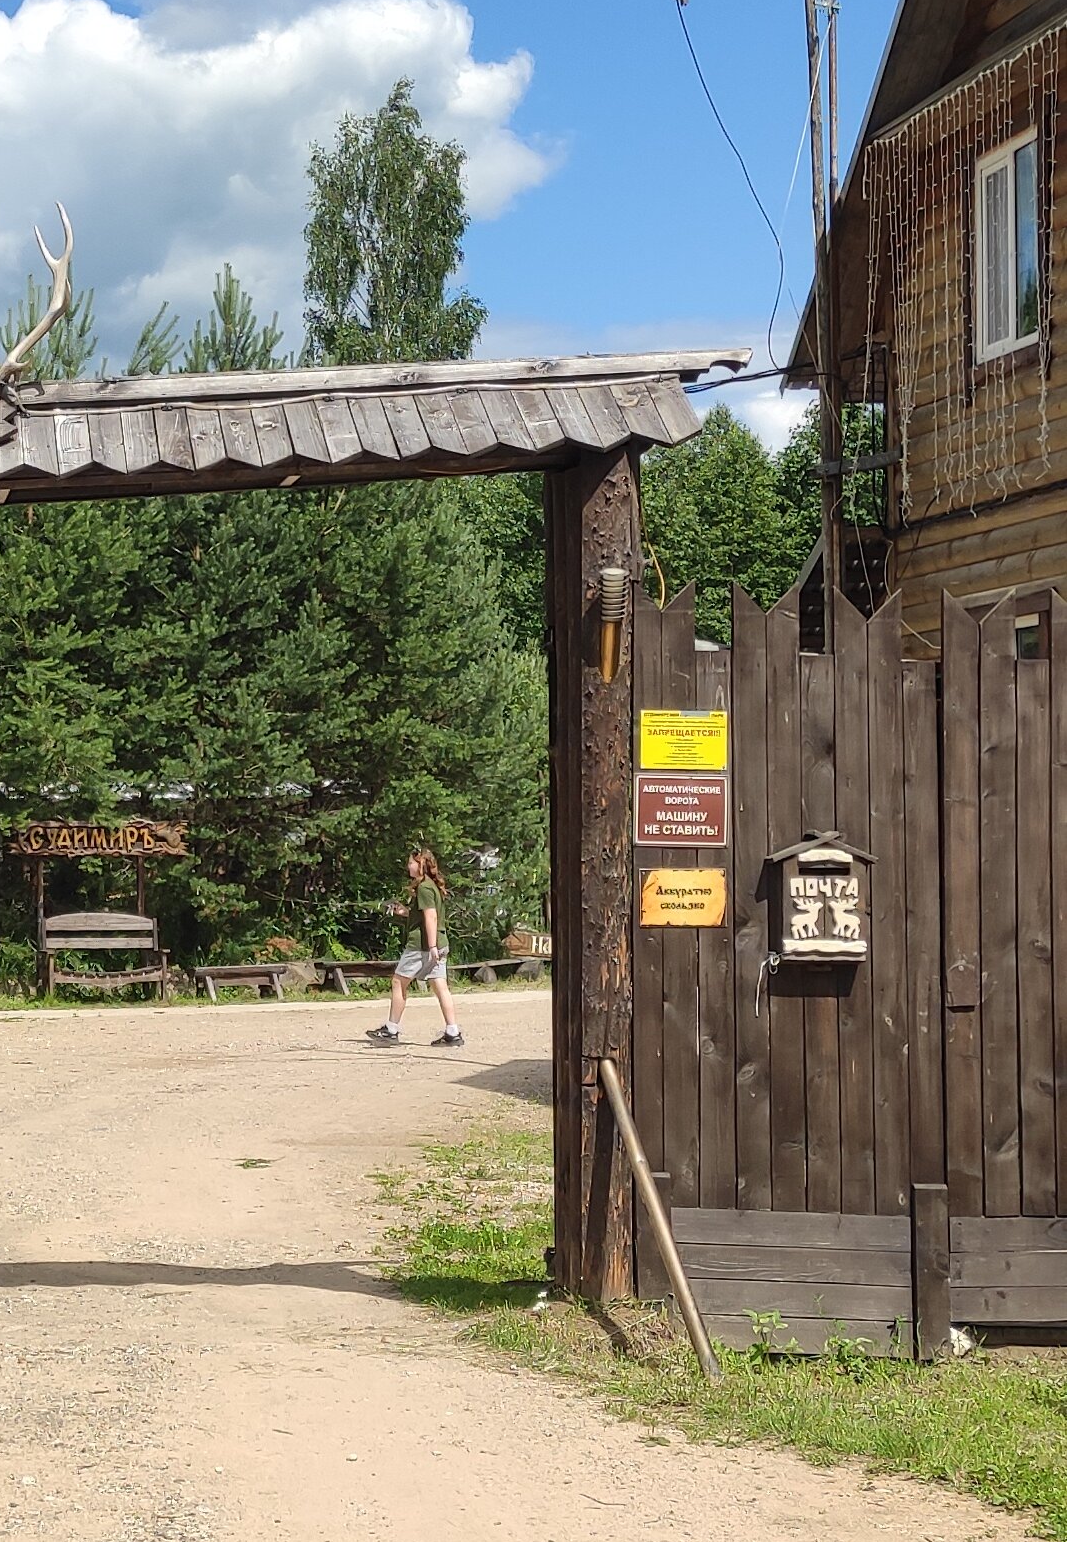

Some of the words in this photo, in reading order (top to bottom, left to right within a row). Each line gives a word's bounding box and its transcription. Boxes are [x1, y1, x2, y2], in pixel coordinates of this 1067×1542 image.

[642, 784, 721, 794] АВТОМАТИЧЕСКИЕ
[664, 796, 700, 805] ВОРОТА
[656, 810, 708, 822] МАШИНУ
[644, 824, 661, 835] НЕ
[662, 825, 719, 836] СТАВИТЬ!
[655, 885, 712, 898] Аккуратно
[790, 877, 859, 898] ПОЧТА
[660, 902, 705, 910] скользко
